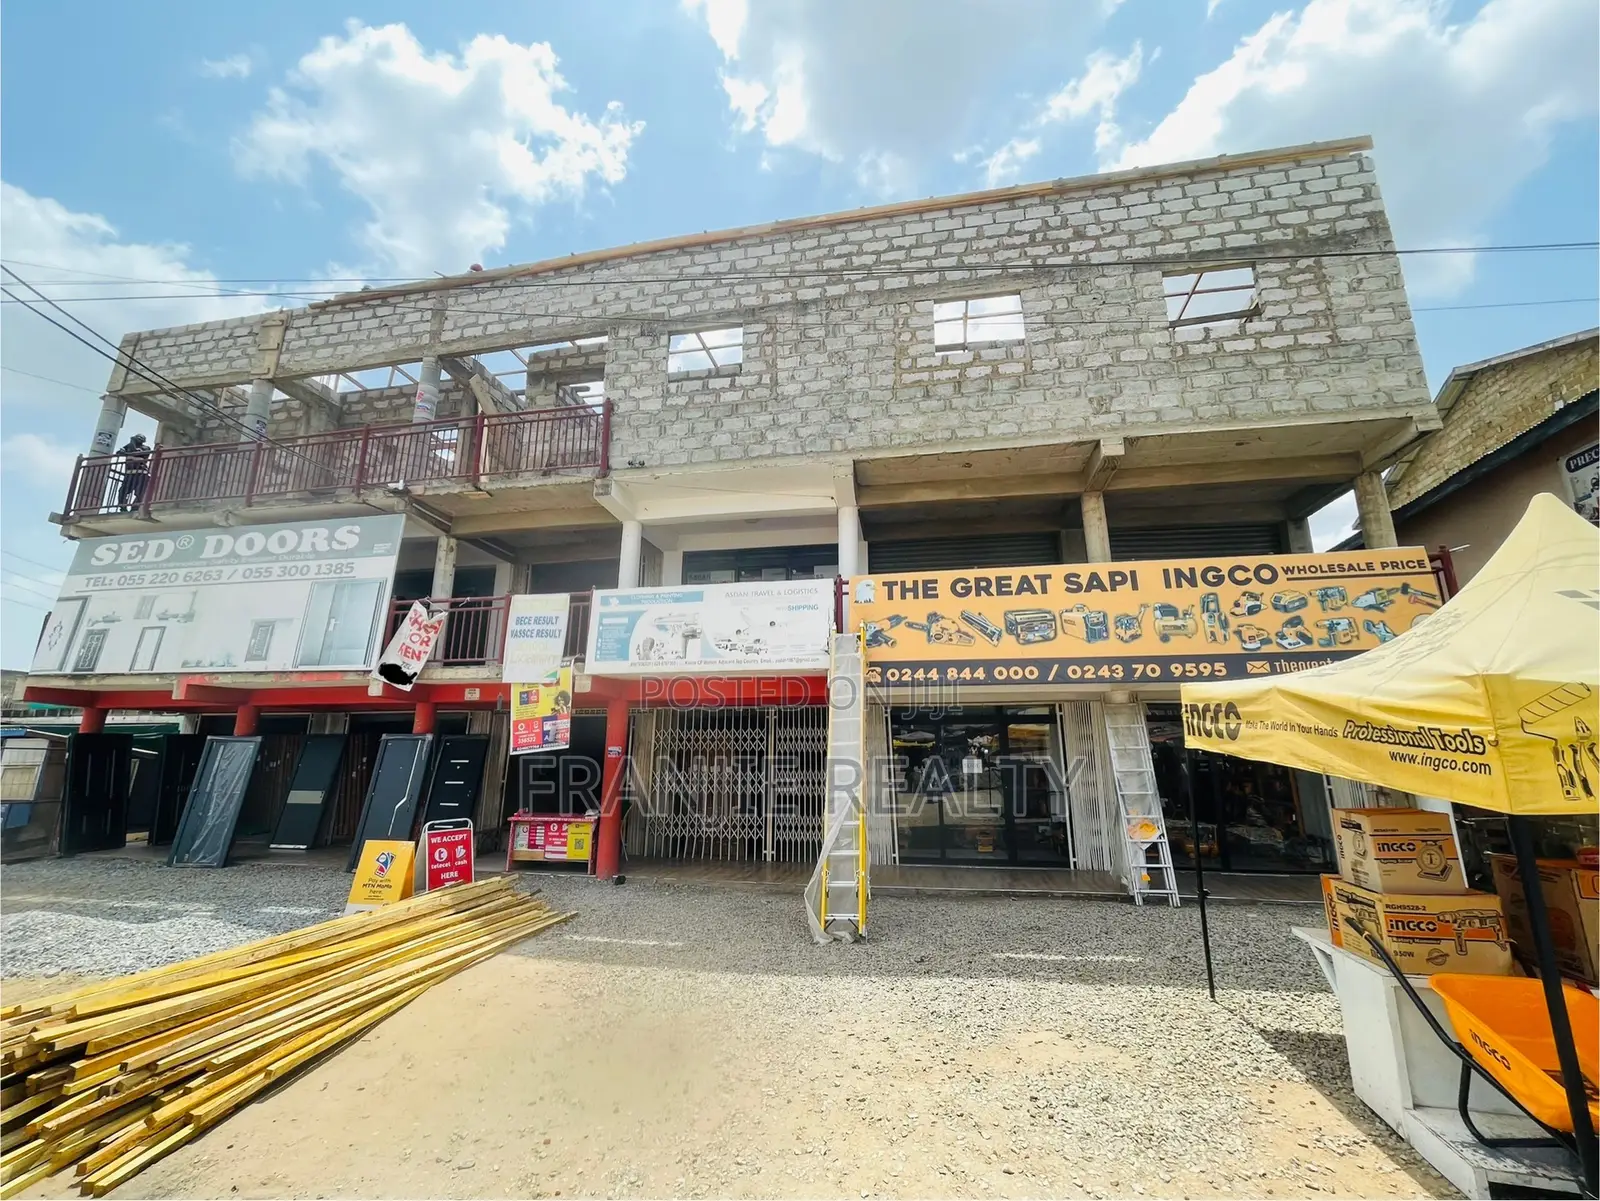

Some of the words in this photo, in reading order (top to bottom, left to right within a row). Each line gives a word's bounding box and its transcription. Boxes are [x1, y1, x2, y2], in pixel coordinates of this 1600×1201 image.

[200, 525, 361, 559] DOORS
[85, 576, 113, 588] TEL:
[117, 574, 146, 586] 055
[148, 572, 179, 585] 220
[183, 569, 223, 583] 6263
[227, 569, 238, 580] /
[242, 566, 272, 579] 055
[277, 564, 311, 577] 300
[314, 562, 355, 576] 1385
[1281, 561, 1375, 576] WHOLESALE
[1380, 559, 1427, 571] PRICE
[882, 578, 939, 601] THE
[950, 574, 1052, 597] GREAT
[1063, 570, 1139, 593] SAPI
[1162, 563, 1279, 589] INGCO
[515, 616, 532, 626] BECE
[533, 615, 560, 625] RESULT
[536, 628, 562, 638] RESULT
[886, 666, 939, 682] 0244
[946, 666, 986, 681] 844
[993, 665, 1039, 680] 000
[1048, 663, 1060, 682] /
[1067, 663, 1125, 679] 0243
[1132, 662, 1161, 677] 70
[1170, 661, 1227, 677] 9595
[1260, 720, 1269, 730] The
[1270, 721, 1288, 732] World
[1289, 722, 1296, 732] In
[1296, 723, 1312, 735] Your
[1314, 726, 1338, 738] Hands
[1343, 720, 1436, 750] Professional
[1428, 727, 1486, 755] Tools
[1389, 750, 1492, 775] www.ingco.com
[431, 836, 441, 844] WE
[442, 833, 467, 843] ACCEPT
[431, 861, 451, 870] telecel
[440, 871, 459, 880] HERE
[1393, 949, 1415, 958] 950W
